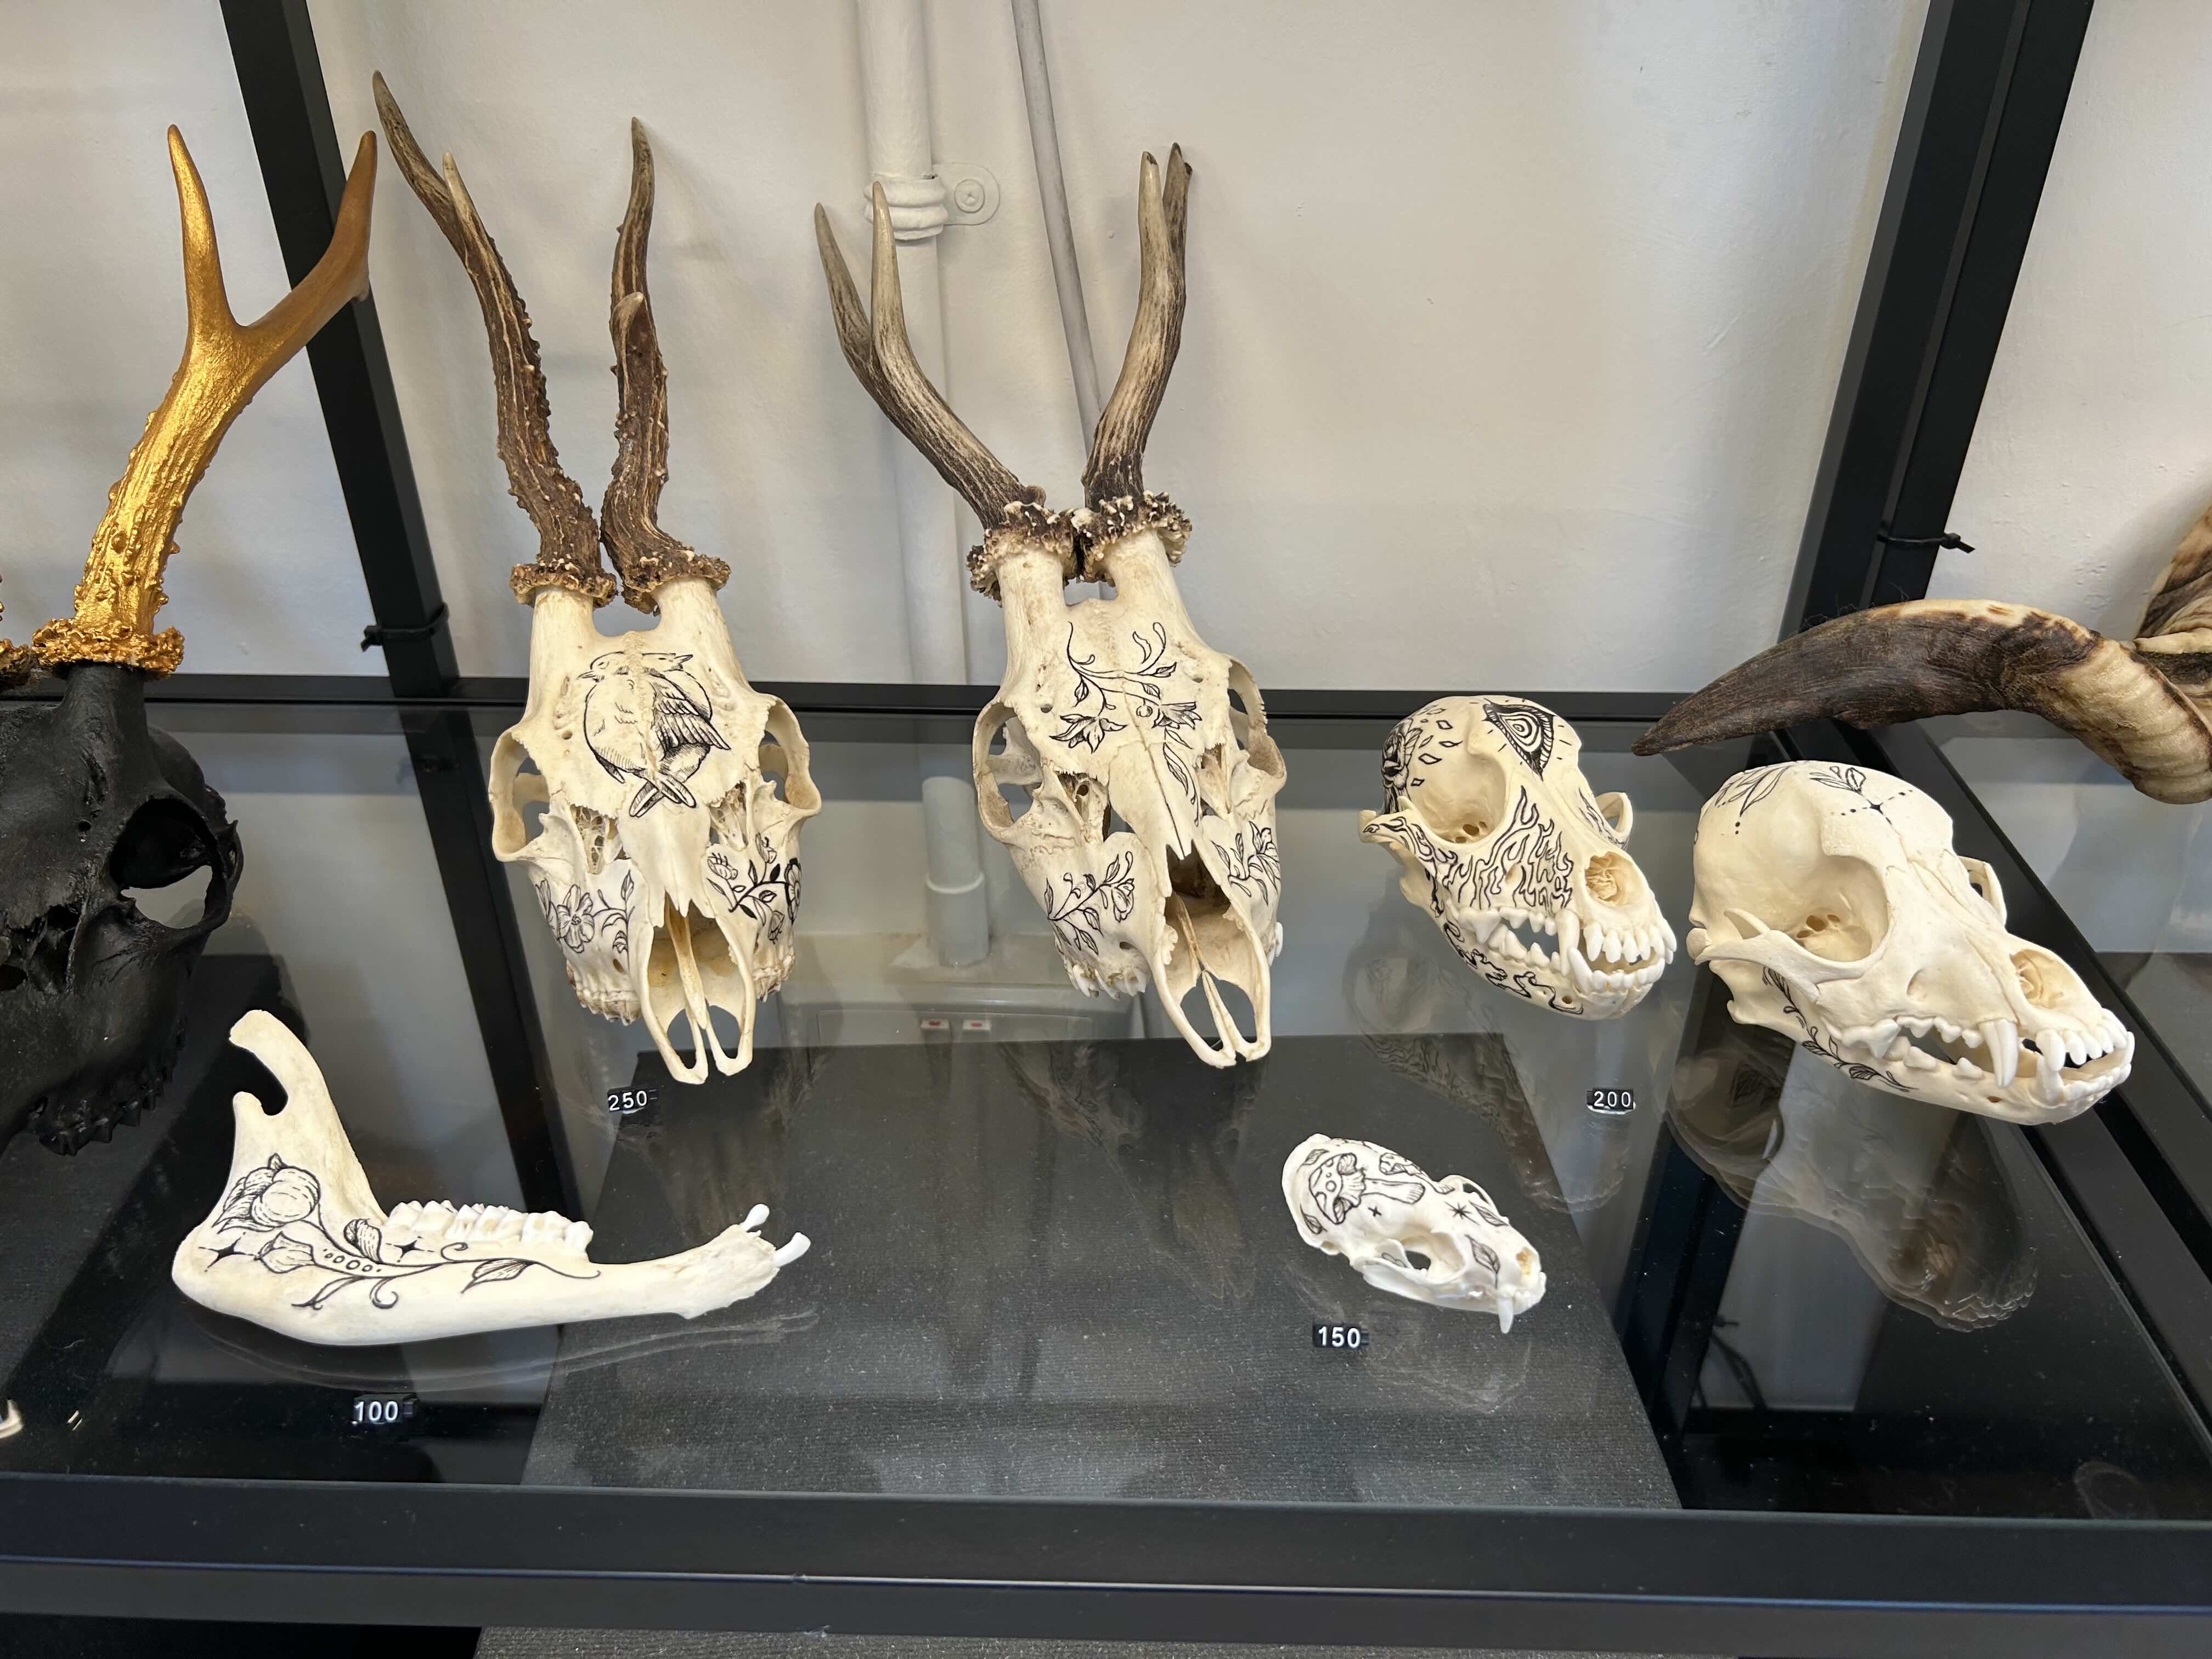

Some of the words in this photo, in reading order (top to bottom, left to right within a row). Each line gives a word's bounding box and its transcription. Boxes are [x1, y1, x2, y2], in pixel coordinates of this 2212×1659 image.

[608, 1090, 647, 1111] 250
[1593, 1091, 1632, 1108] 200
[1318, 1326, 1361, 1348] 150
[354, 1401, 399, 1422] 100
